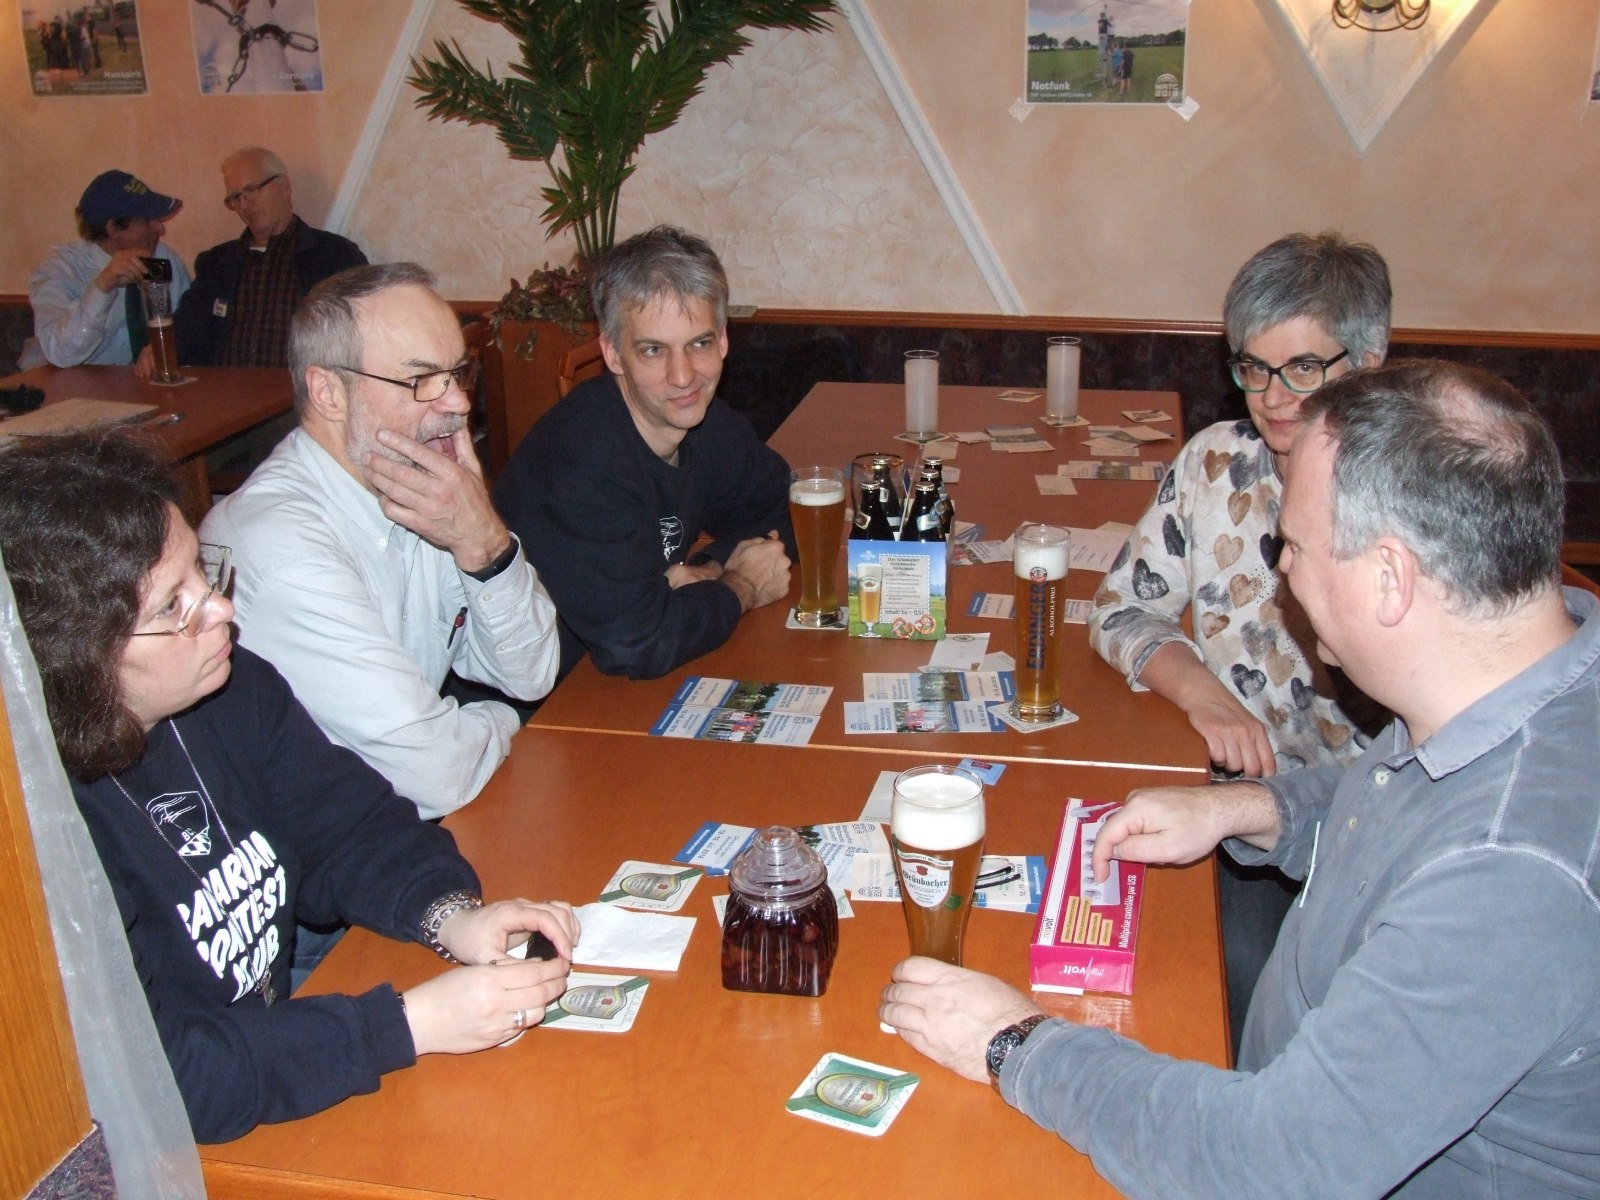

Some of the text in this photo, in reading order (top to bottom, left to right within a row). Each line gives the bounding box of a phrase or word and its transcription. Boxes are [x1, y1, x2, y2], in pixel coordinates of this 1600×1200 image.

[1031, 81, 1070, 90] Notfunk
[1026, 581, 1048, 669] ERDINGER
[1118, 874, 1137, 948] Multiprise contrôlée par USB
